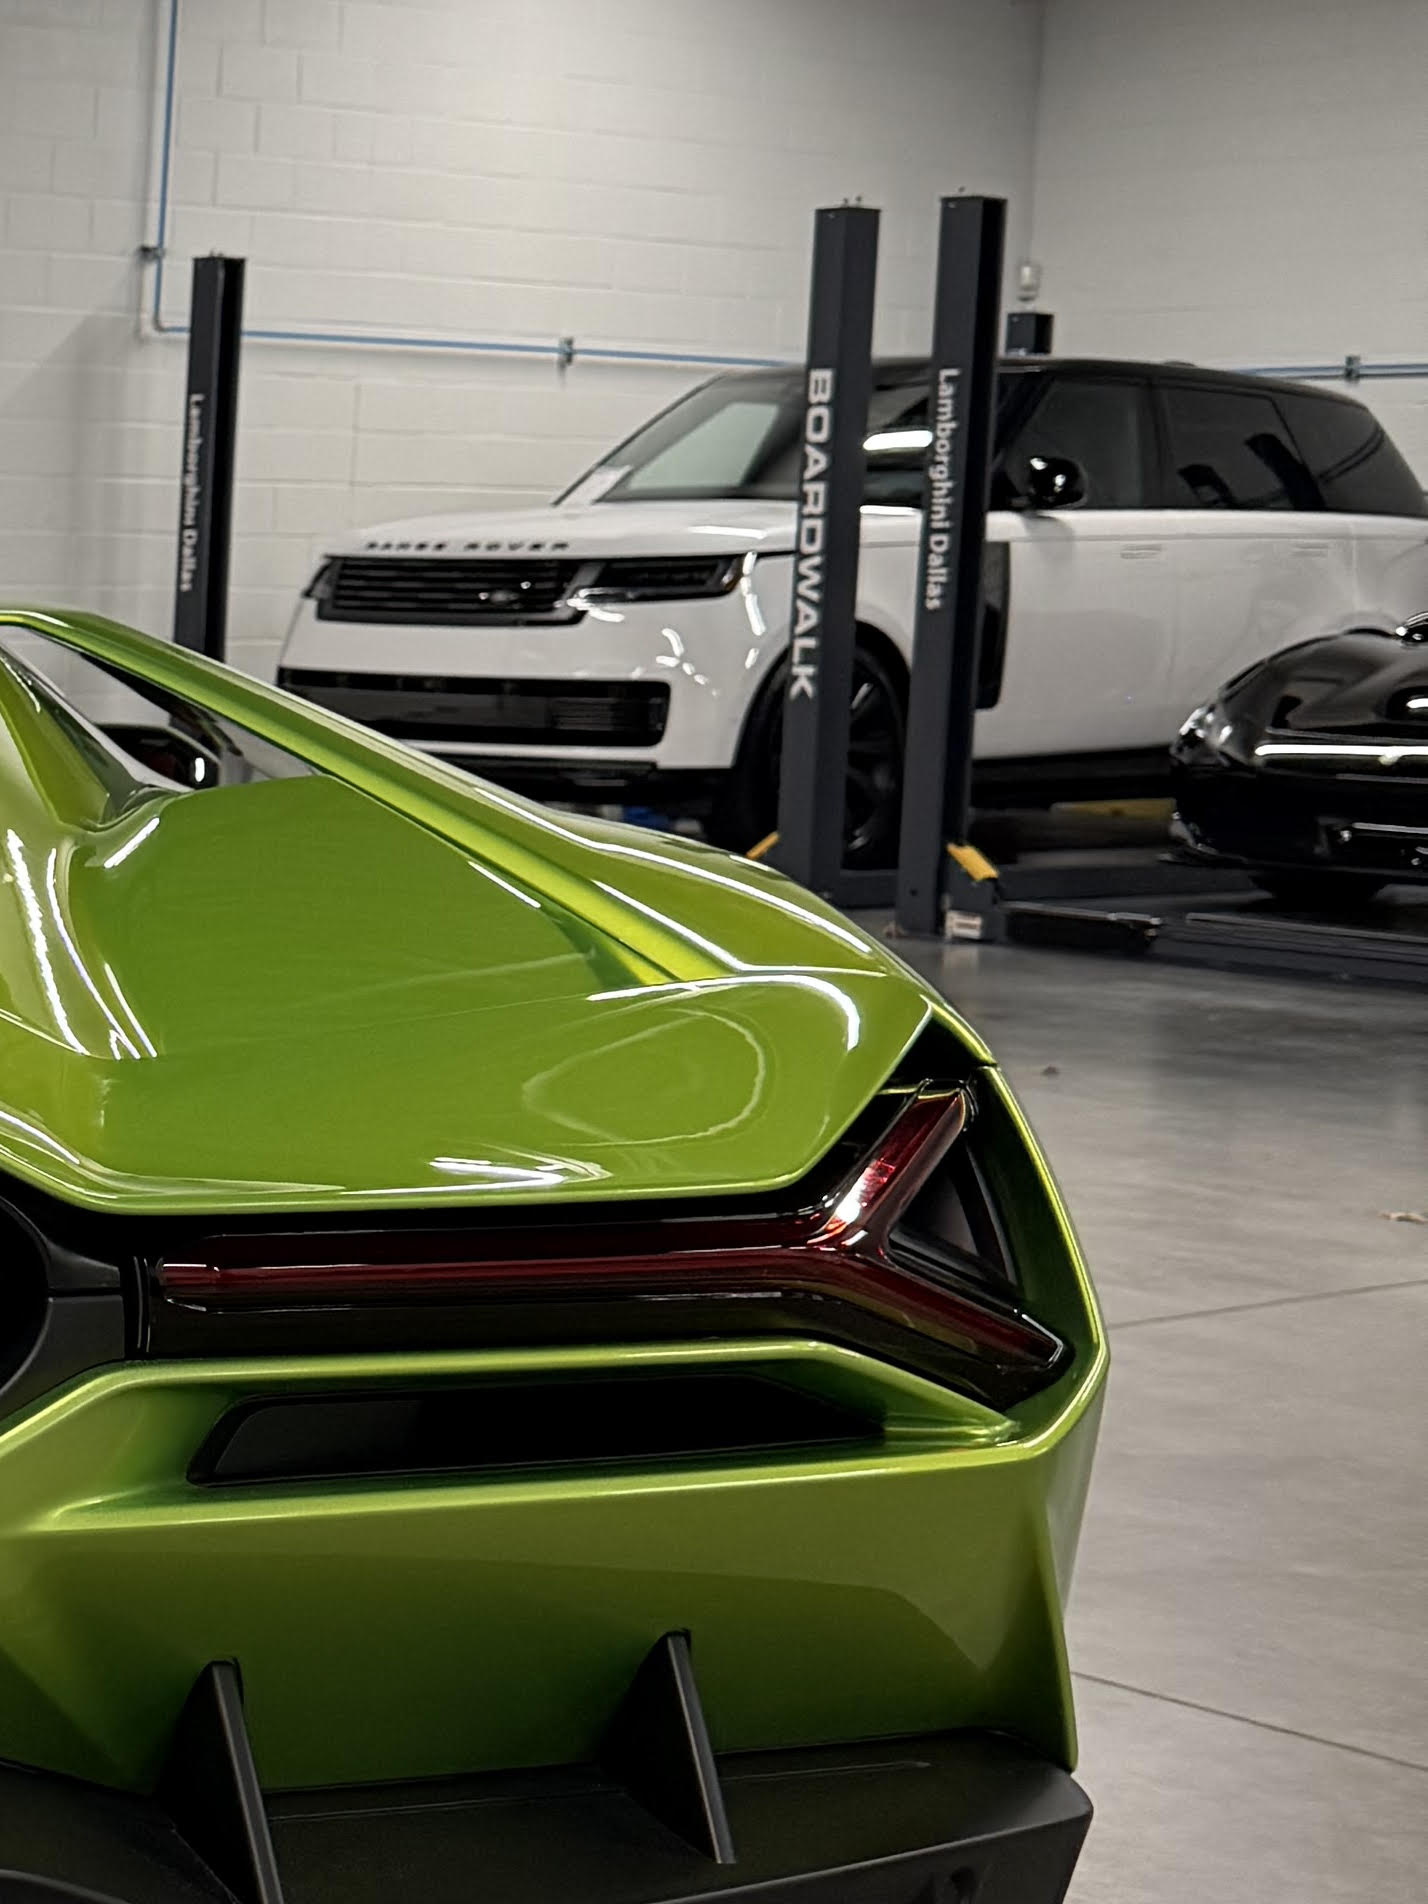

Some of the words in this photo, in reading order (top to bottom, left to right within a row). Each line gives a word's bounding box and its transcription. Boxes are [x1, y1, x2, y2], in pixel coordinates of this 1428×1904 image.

[929, 368, 960, 528] Lamborghini
[790, 368, 833, 699] BOARDWALK
[925, 535, 951, 610] Dallas
